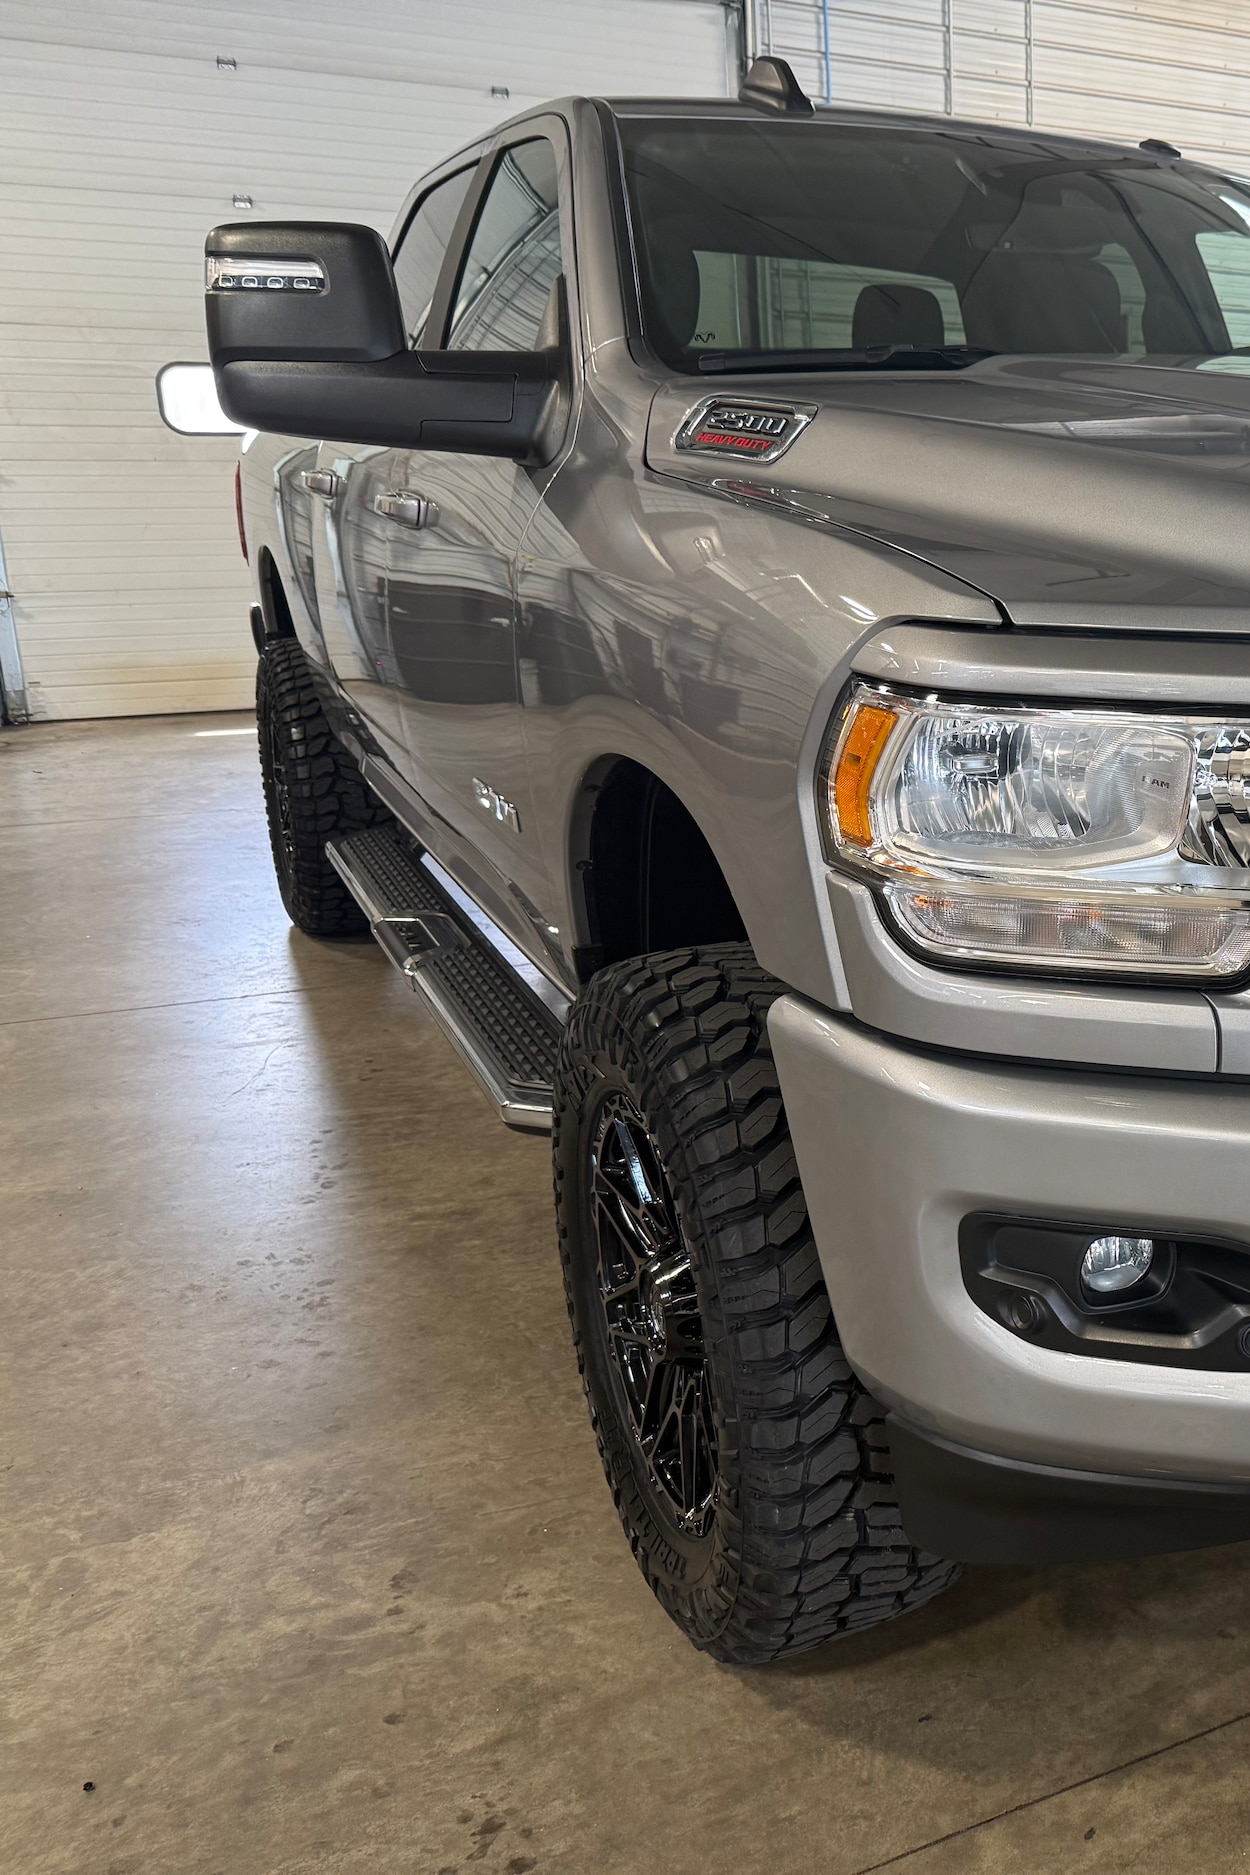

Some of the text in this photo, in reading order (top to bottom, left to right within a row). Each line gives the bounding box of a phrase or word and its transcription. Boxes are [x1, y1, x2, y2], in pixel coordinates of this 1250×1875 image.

[707, 411, 788, 437] 2500
[697, 433, 772, 450] HEAVY DUTY
[1142, 775, 1170, 789] RAM
